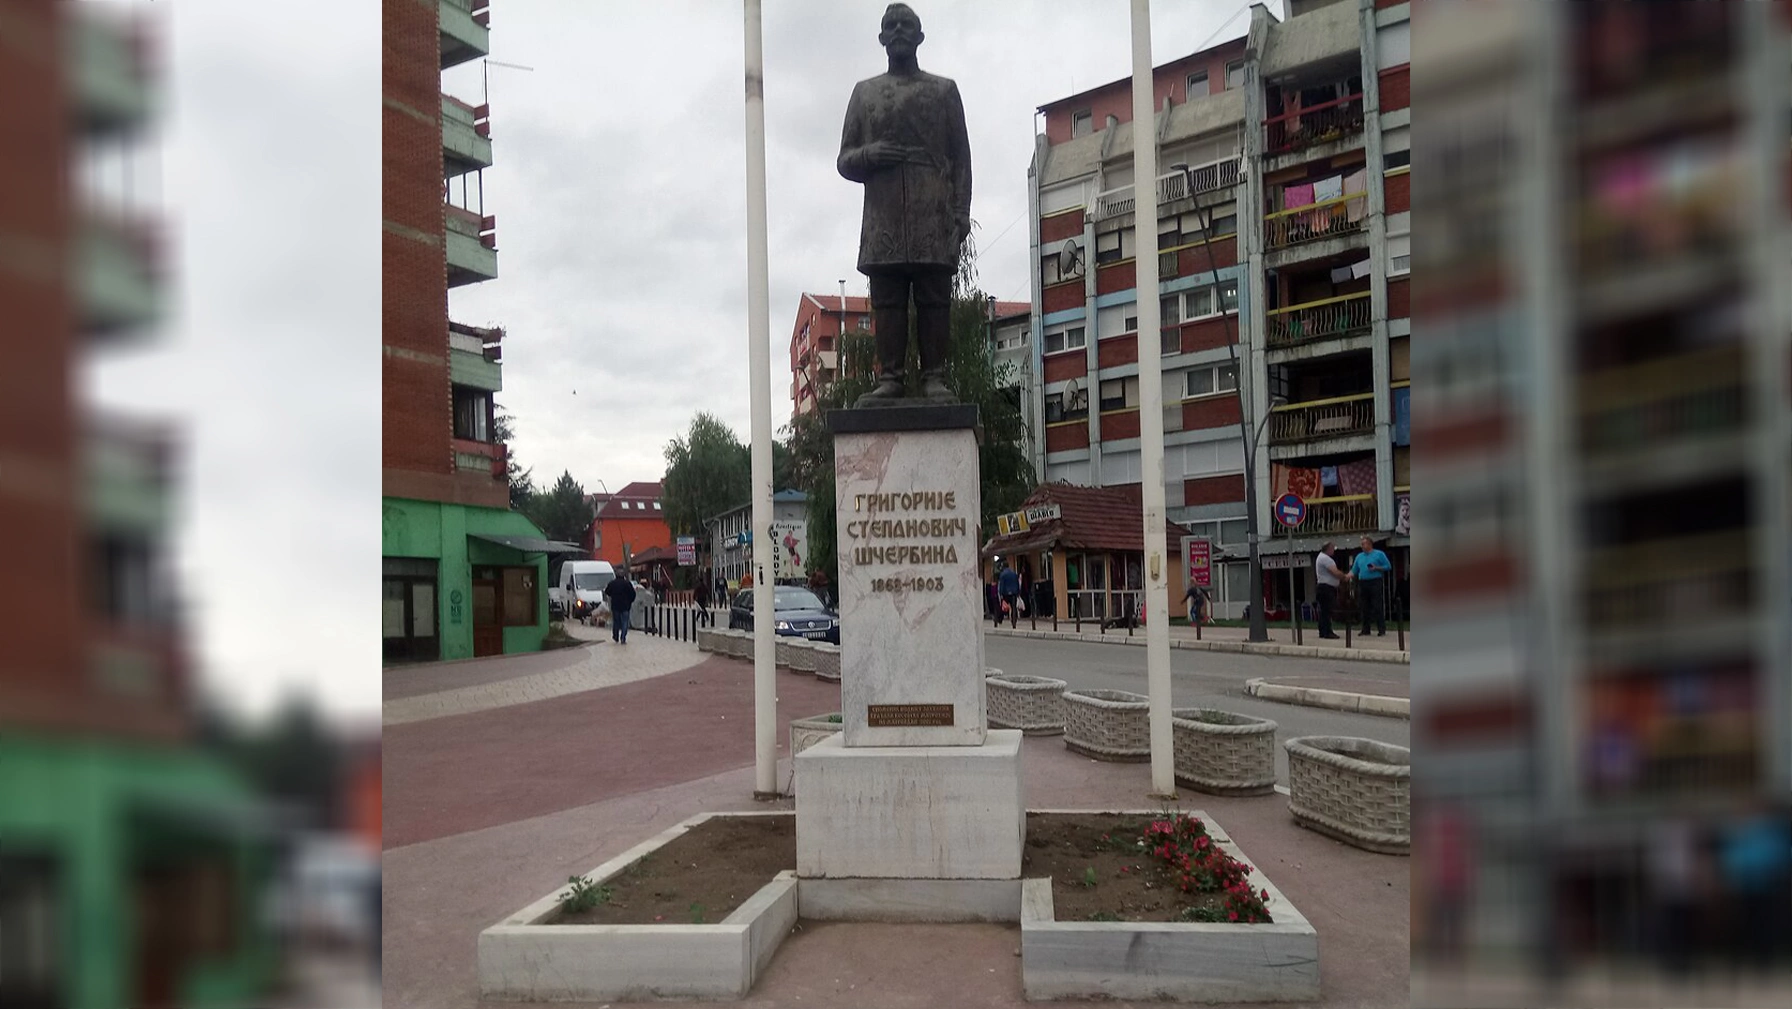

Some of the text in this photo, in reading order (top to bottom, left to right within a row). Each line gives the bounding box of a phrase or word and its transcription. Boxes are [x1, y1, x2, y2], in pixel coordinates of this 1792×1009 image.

[854, 490, 956, 513] ГРИГОРИЈЕ
[846, 517, 967, 540] СТЕПАНОВИЧ
[854, 544, 958, 566] ШЧЕРБИНА
